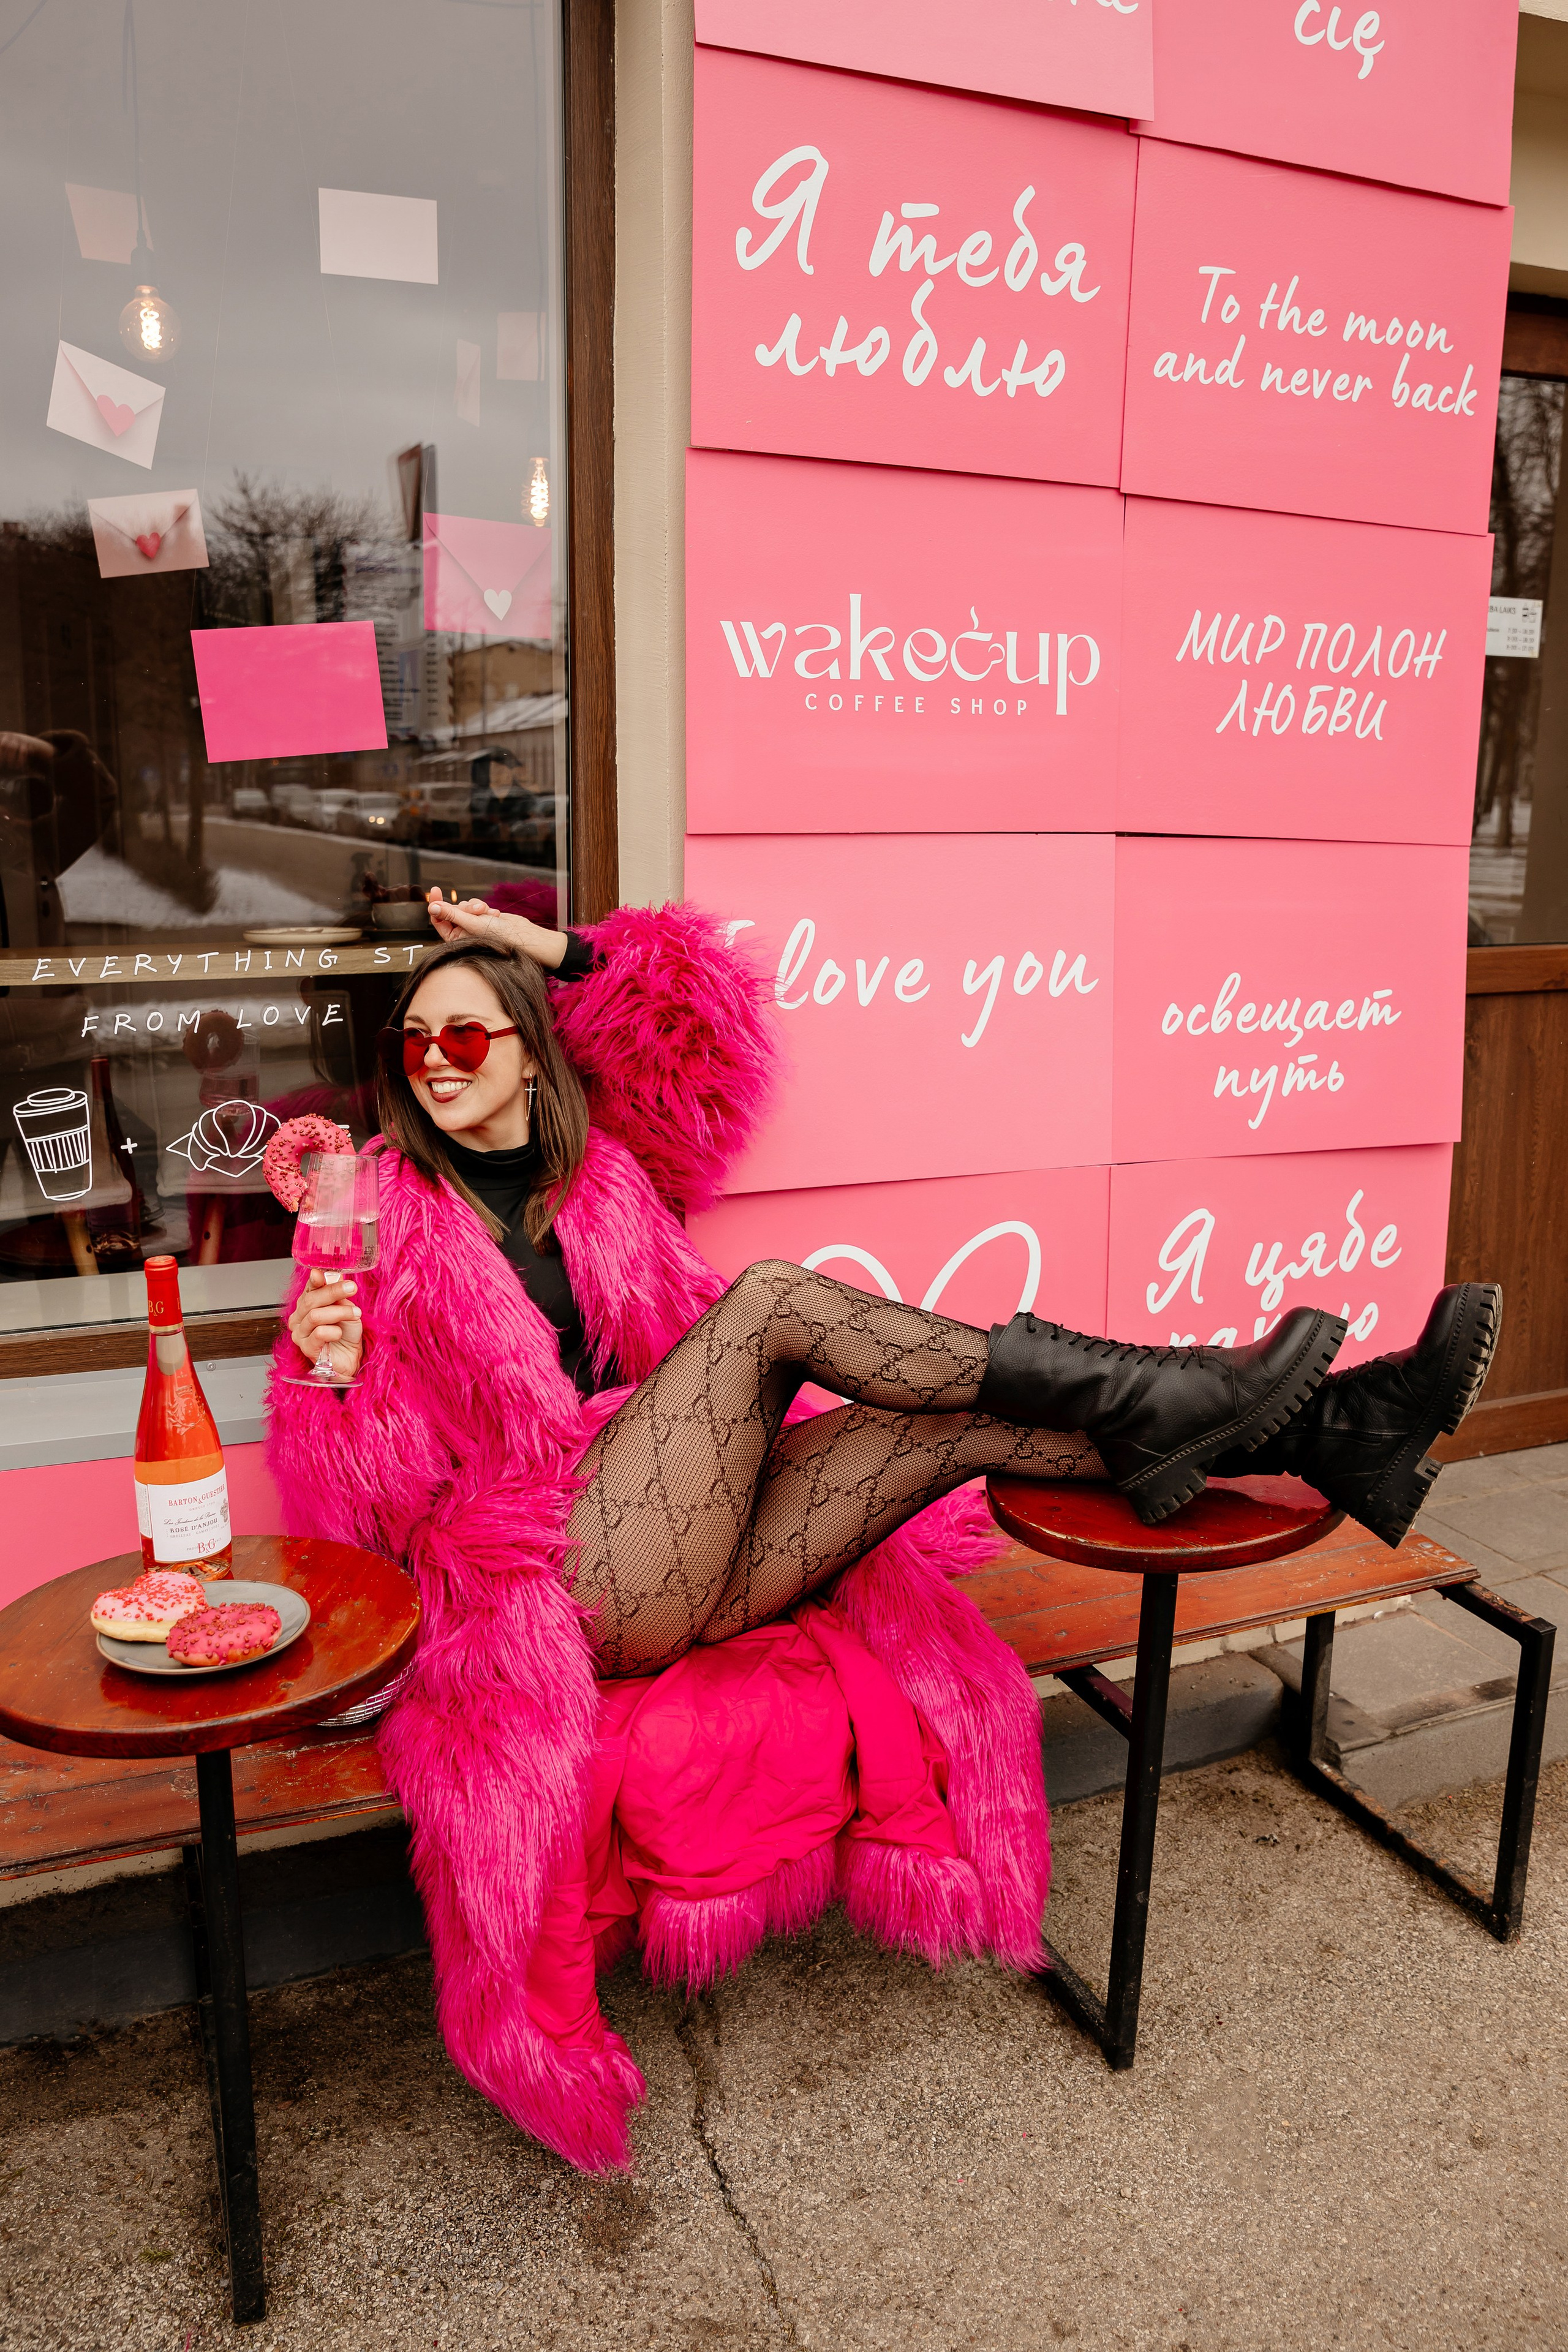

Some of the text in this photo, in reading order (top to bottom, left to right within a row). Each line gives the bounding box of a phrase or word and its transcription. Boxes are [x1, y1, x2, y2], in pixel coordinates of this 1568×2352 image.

[736, 145, 1101, 303] Я тебя
[755, 279, 1066, 398] люблю
[1199, 266, 1453, 353] To the moon
[1153, 334, 1477, 416] and never back
[1175, 609, 1447, 678] МИР ПОЛОН
[805, 693, 1027, 715] COFFEE SHOP
[1216, 679, 1387, 741] ЛЮБВИ
[32, 948, 338, 981] EVERYTHING
[775, 918, 1099, 1048] love you
[81, 1004, 344, 1038] FROM LOVE
[1161, 972, 1401, 1048] освещает
[1213, 1054, 1344, 1129] путь
[1146, 1189, 1402, 1314] Я цябе
[148, 1300, 164, 1316] B&G
[197, 1538, 215, 1553] B&G
